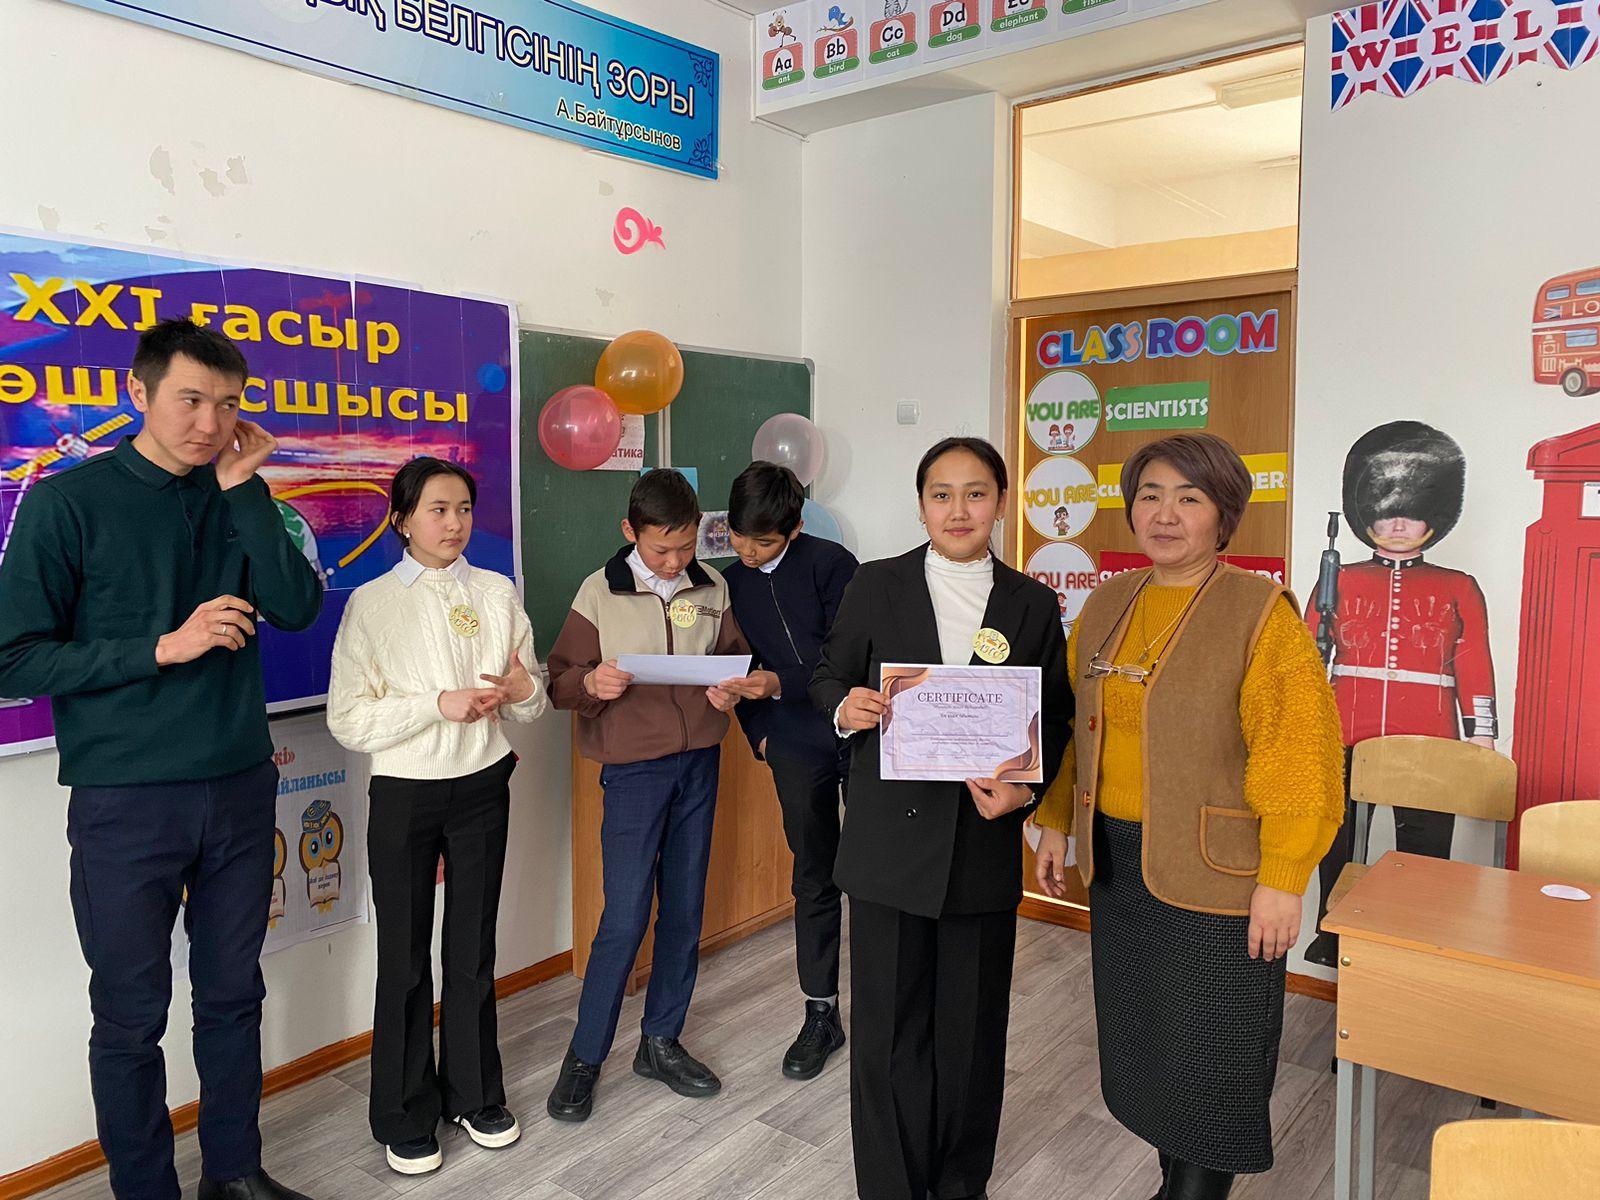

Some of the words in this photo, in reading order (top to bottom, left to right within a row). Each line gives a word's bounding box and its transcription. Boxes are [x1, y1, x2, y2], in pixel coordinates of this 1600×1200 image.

[942, 2, 966, 26] Dd
[999, 12, 1039, 29] elephant
[881, 25, 904, 43] Cc
[946, 32, 963, 42] dog
[1347, 9, 1600, 72] WEL
[826, 38, 846, 59] Bb
[774, 57, 793, 73] Aa
[828, 61, 845, 74] bird
[606, 59, 697, 119] ЗОРЫ
[778, 75, 791, 85] ant
[1038, 321, 1143, 367] CLASS
[1147, 309, 1279, 359] ROOM
[1027, 401, 1063, 421] YOU
[1066, 399, 1099, 420] ARE
[1104, 396, 1209, 422] SCIENTISTS
[1024, 488, 1060, 509] YOU
[1063, 483, 1096, 504] ARE
[1065, 572, 1096, 589] ARE
[917, 692, 1004, 704] CERTIFICATE
[277, 768, 346, 796] йланысы
